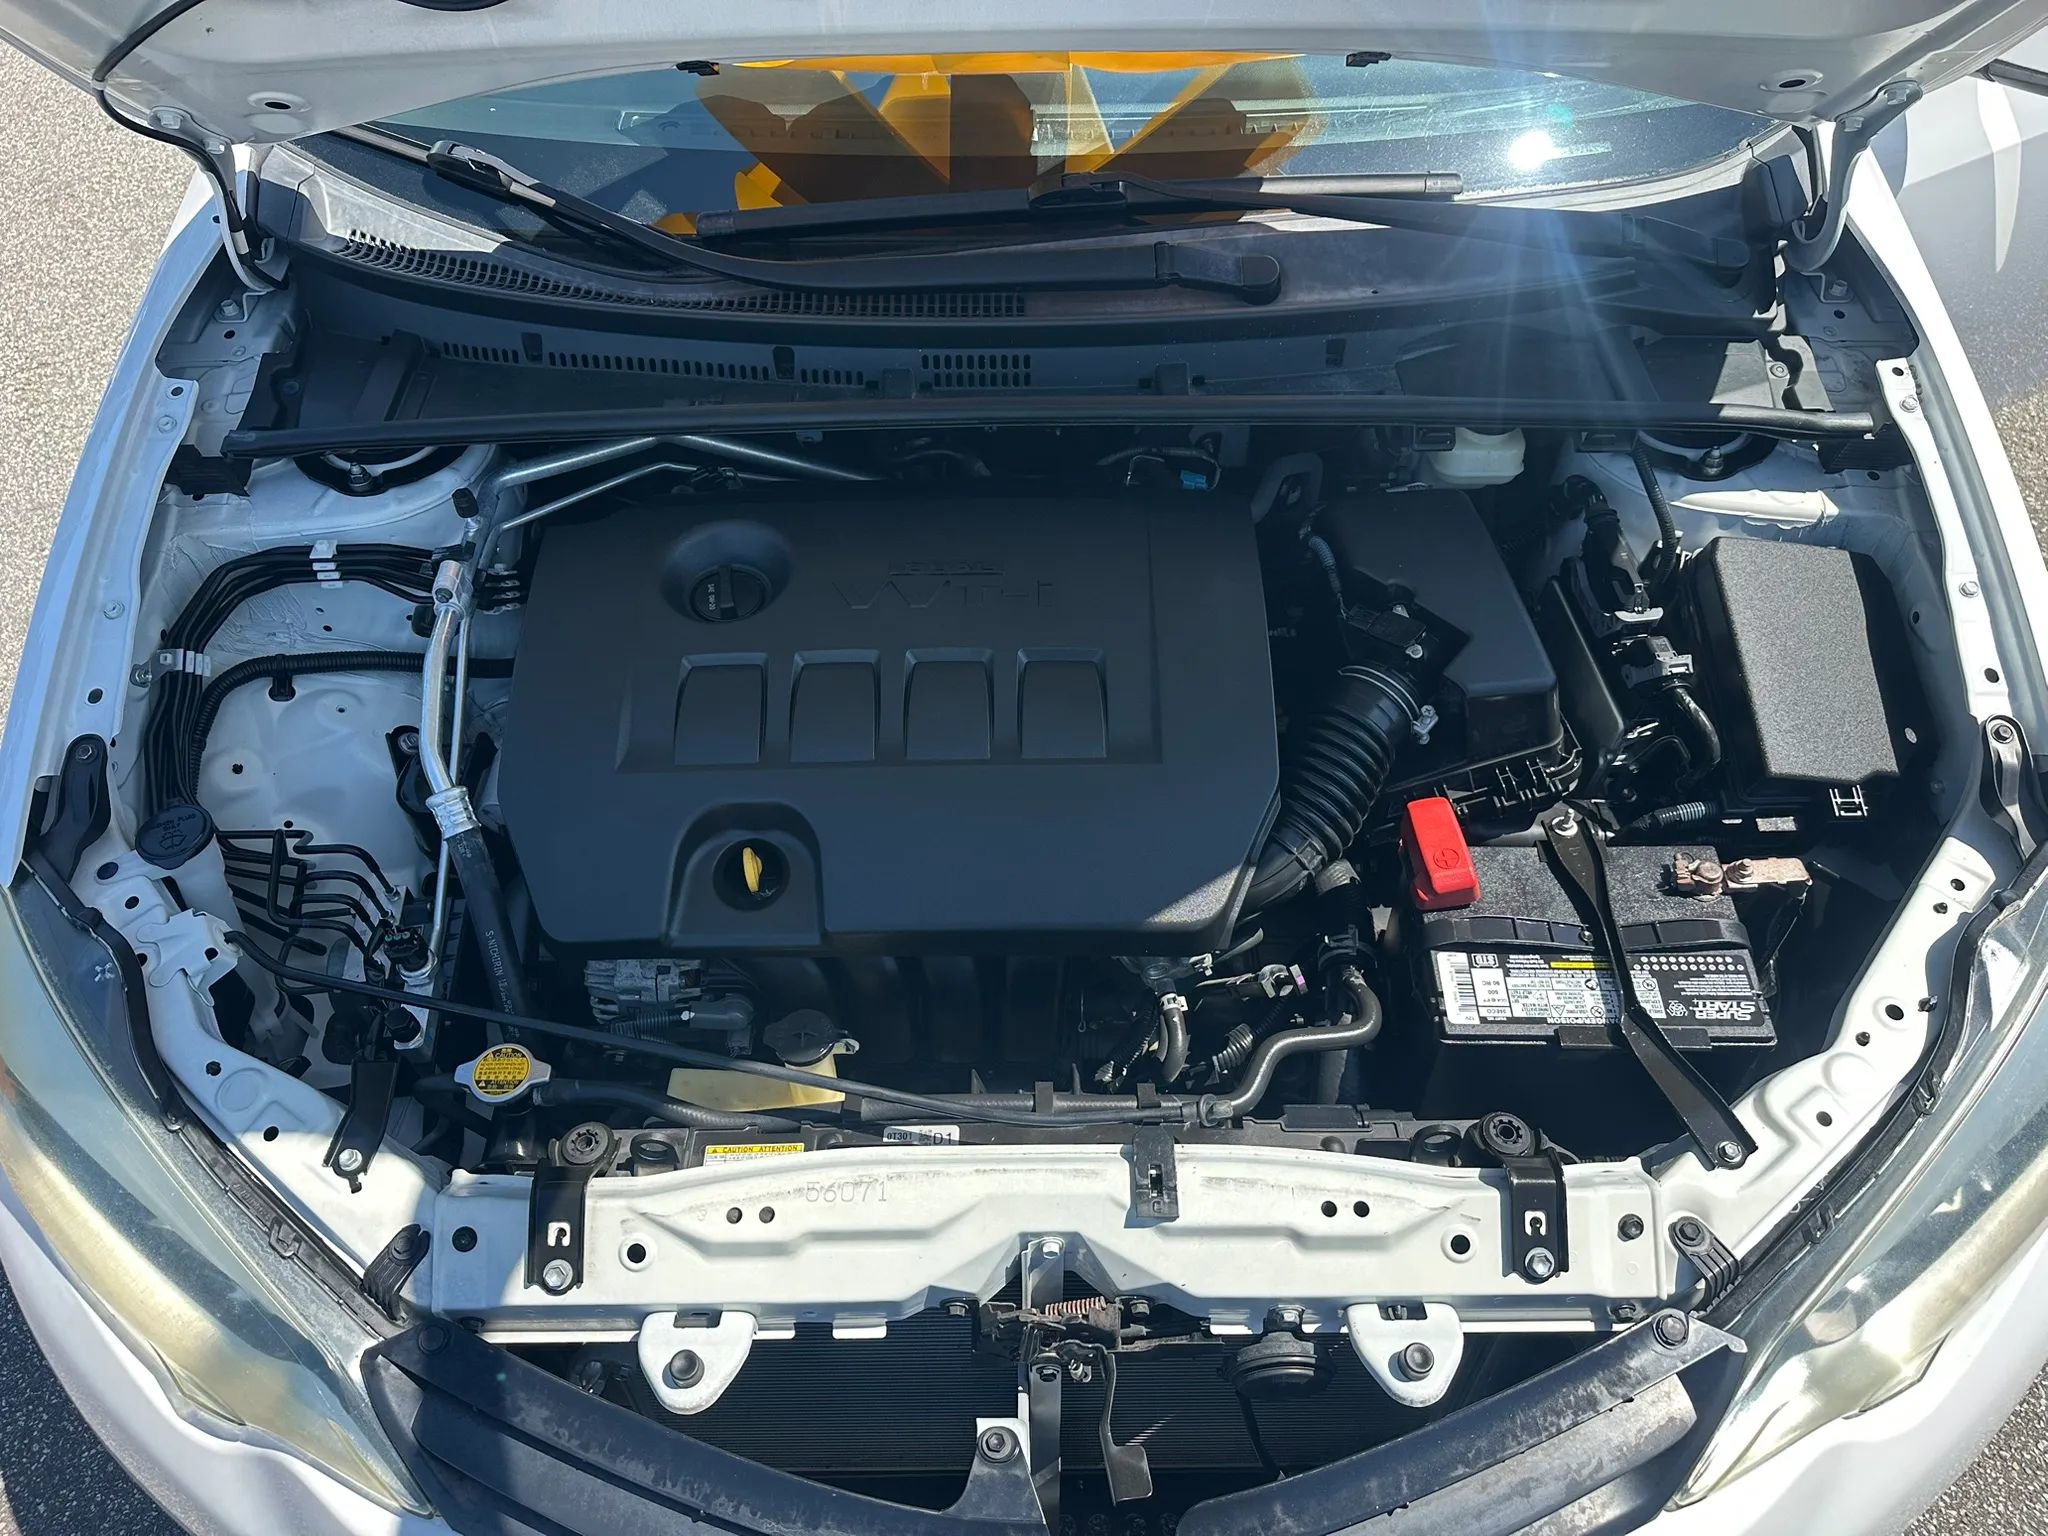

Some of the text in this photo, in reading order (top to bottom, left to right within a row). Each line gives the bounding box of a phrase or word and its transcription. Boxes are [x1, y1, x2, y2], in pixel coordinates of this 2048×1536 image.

[1695, 1000, 1756, 1013] START
[1695, 1010, 1751, 1020] SUPER
[933, 1132, 952, 1145] D1
[806, 1181, 887, 1202] 56071
